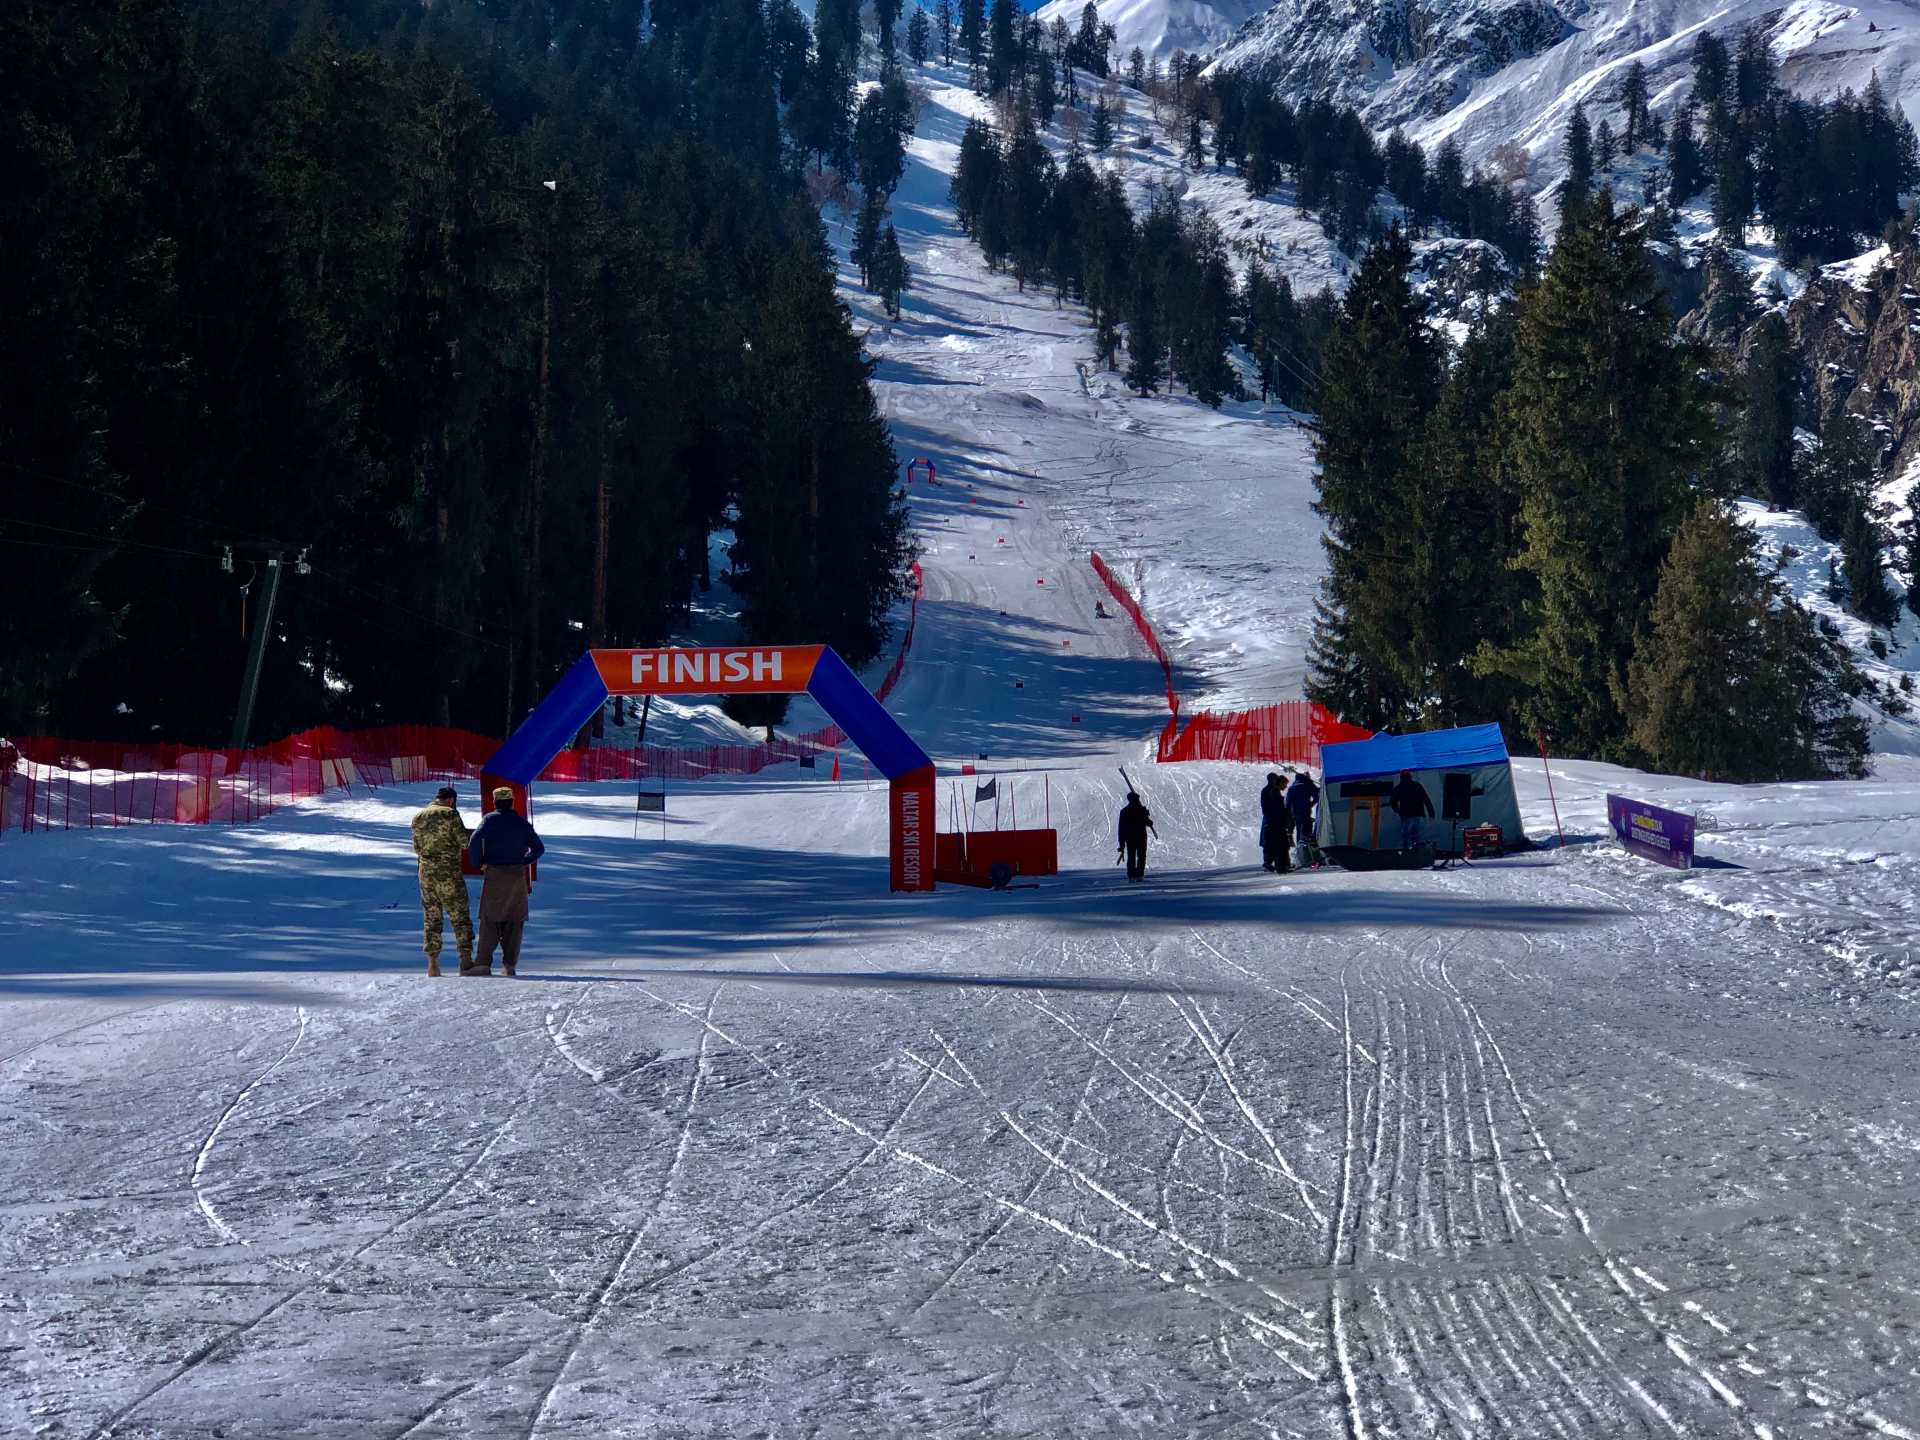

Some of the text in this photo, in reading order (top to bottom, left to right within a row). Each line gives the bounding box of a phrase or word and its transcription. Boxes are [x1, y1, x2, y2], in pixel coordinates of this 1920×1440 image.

[631, 651, 783, 684] FINISH
[903, 791, 921, 886] NALTAR SKI RESORT
